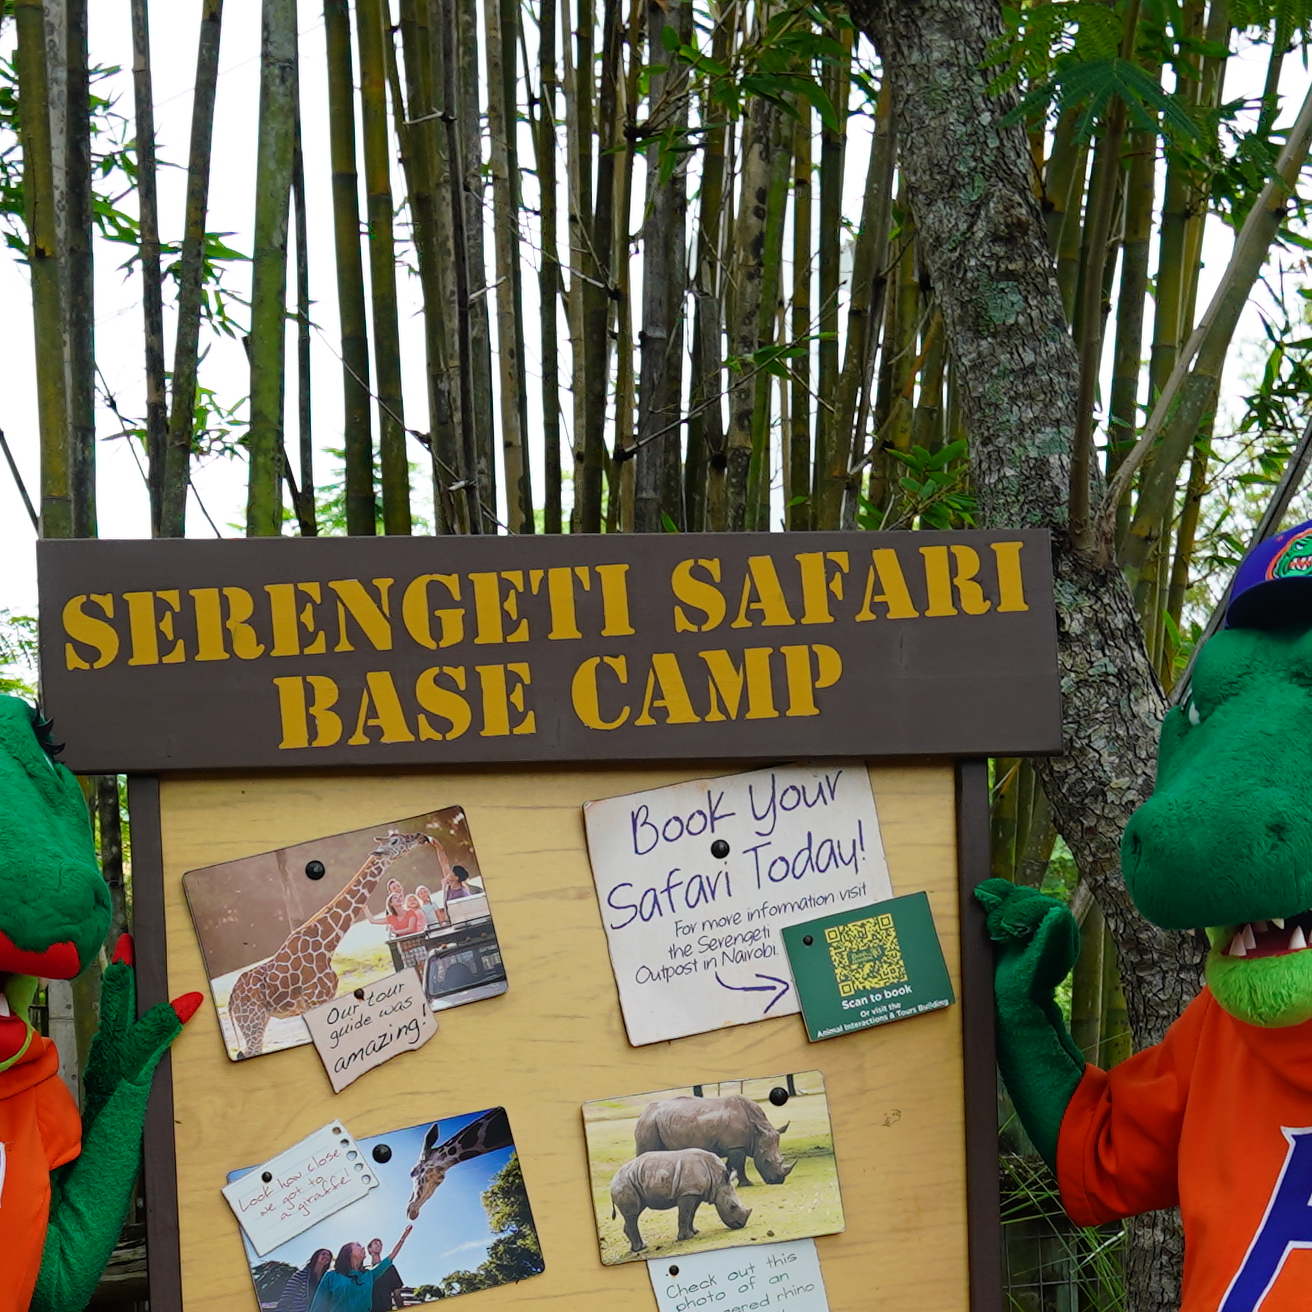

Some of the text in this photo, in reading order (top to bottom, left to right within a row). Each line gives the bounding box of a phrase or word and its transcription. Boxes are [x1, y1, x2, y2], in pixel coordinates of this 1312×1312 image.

[62, 541, 1029, 670] SERENGETI SAFARI
[272, 643, 843, 749] BASE CAMP
[631, 770, 842, 855] Book Your
[607, 820, 866, 929] Safari Today!
[674, 884, 867, 937] For more information visit
[635, 944, 779, 984] Outpost in Nairobi.
[668, 927, 771, 960] the Serengeti
[327, 983, 405, 1024] Our tour
[817, 1025, 843, 1038] Animal
[844, 1015, 888, 1030] Interactions
[896, 1006, 916, 1017] Tours
[918, 999, 949, 1011] Building
[842, 985, 913, 1010] Scan to book
[860, 1010, 870, 1018] Or
[871, 1006, 887, 1015] visit
[330, 996, 413, 1049] guide was
[334, 1004, 426, 1073] amazing!
[238, 1149, 341, 1212] Look how close
[260, 1176, 324, 1216] we got to
[280, 1168, 351, 1220] a giraffe!
[666, 1252, 797, 1299] Check out this
[738, 1277, 756, 1293] of
[769, 1272, 789, 1284] an
[777, 1282, 815, 1301] rhino
